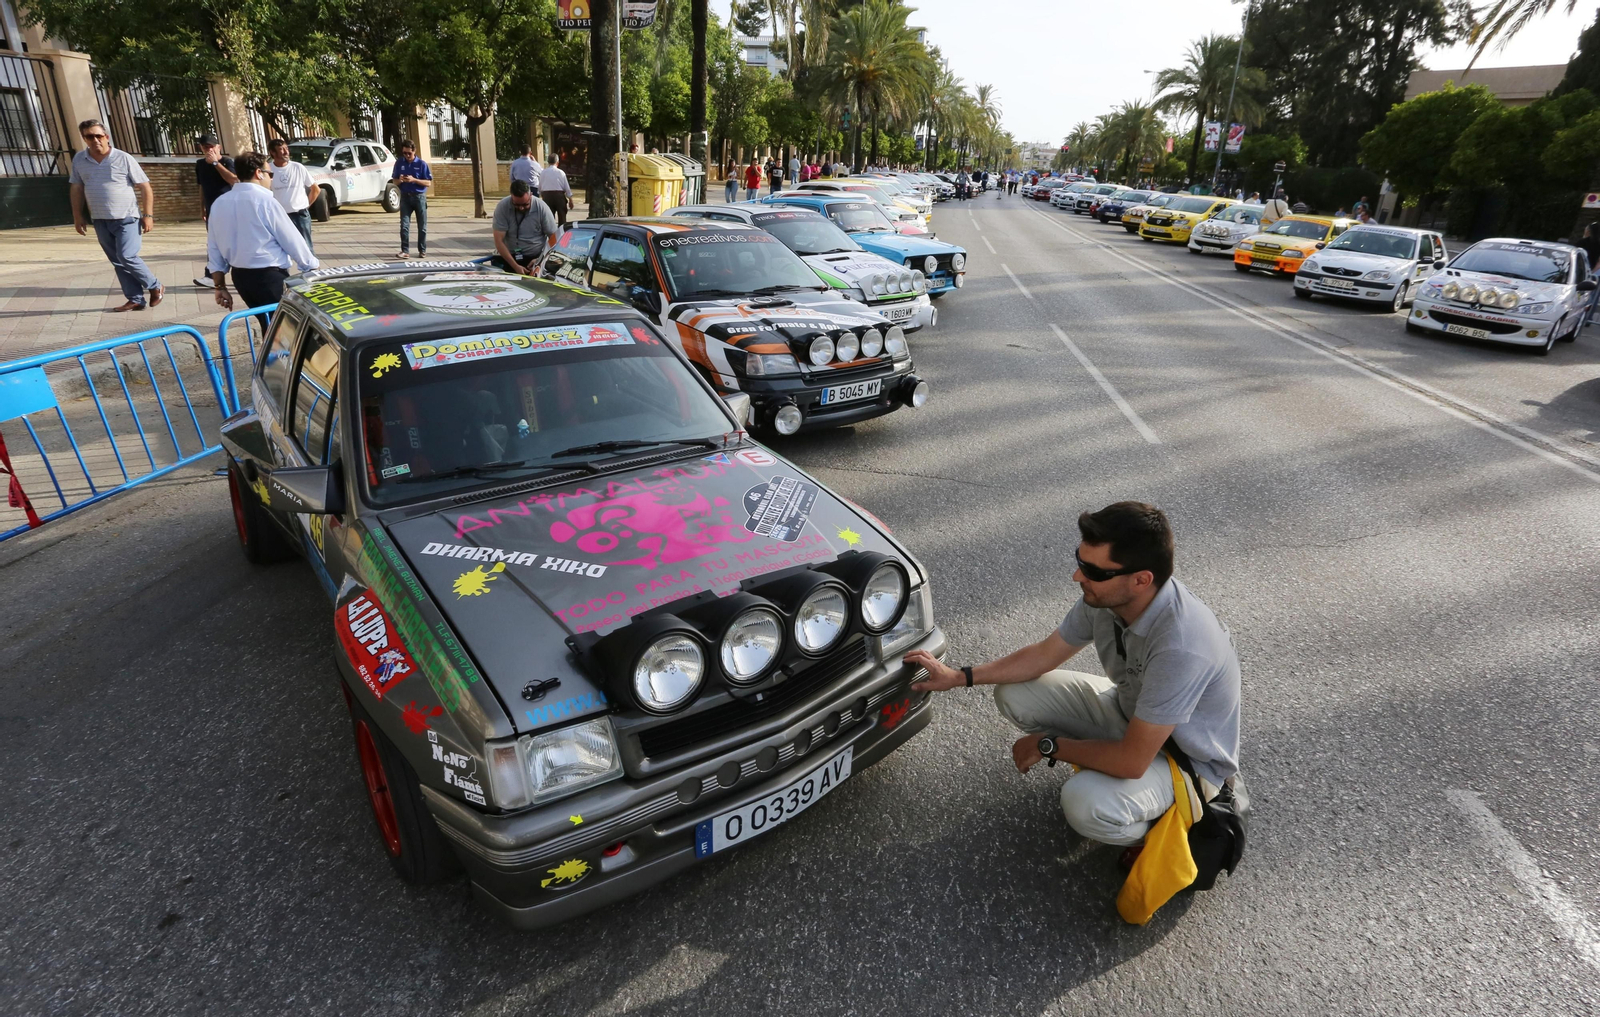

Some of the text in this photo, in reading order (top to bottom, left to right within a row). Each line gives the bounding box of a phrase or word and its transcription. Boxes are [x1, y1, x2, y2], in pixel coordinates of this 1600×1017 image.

[659, 233, 780, 248] enecreativos.com
[311, 262, 391, 278] FRUTERIA
[426, 296, 546, 316] TRABAJOS FORESTALES
[1430, 304, 1520, 324] AUTOESCUELA GABRIEL
[727, 326, 756, 334] Gran
[1448, 325, 1487, 338] 8062 BSL
[410, 330, 584, 360] Domínguez
[532, 339, 584, 350] PINTURA
[829, 381, 880, 400] B 5045 MY
[273, 482, 303, 506] MARIA
[748, 492, 762, 502] 46
[310, 513, 322, 551] 46
[372, 527, 426, 602] ABEL JIMENEZ GUZMAN
[420, 541, 608, 579] DHARMA XIKO
[554, 591, 627, 624] TODO
[635, 568, 697, 596] PARA
[700, 558, 729, 574] TU
[734, 532, 826, 562] MASCOTA
[575, 613, 623, 634] Paseo
[626, 600, 650, 618] del
[708, 570, 746, 588] 11600
[746, 558, 791, 576] Ubrique
[348, 595, 374, 622] LA
[350, 607, 388, 656] LUPE
[751, 778, 814, 830] 0339
[818, 755, 846, 794] AV
